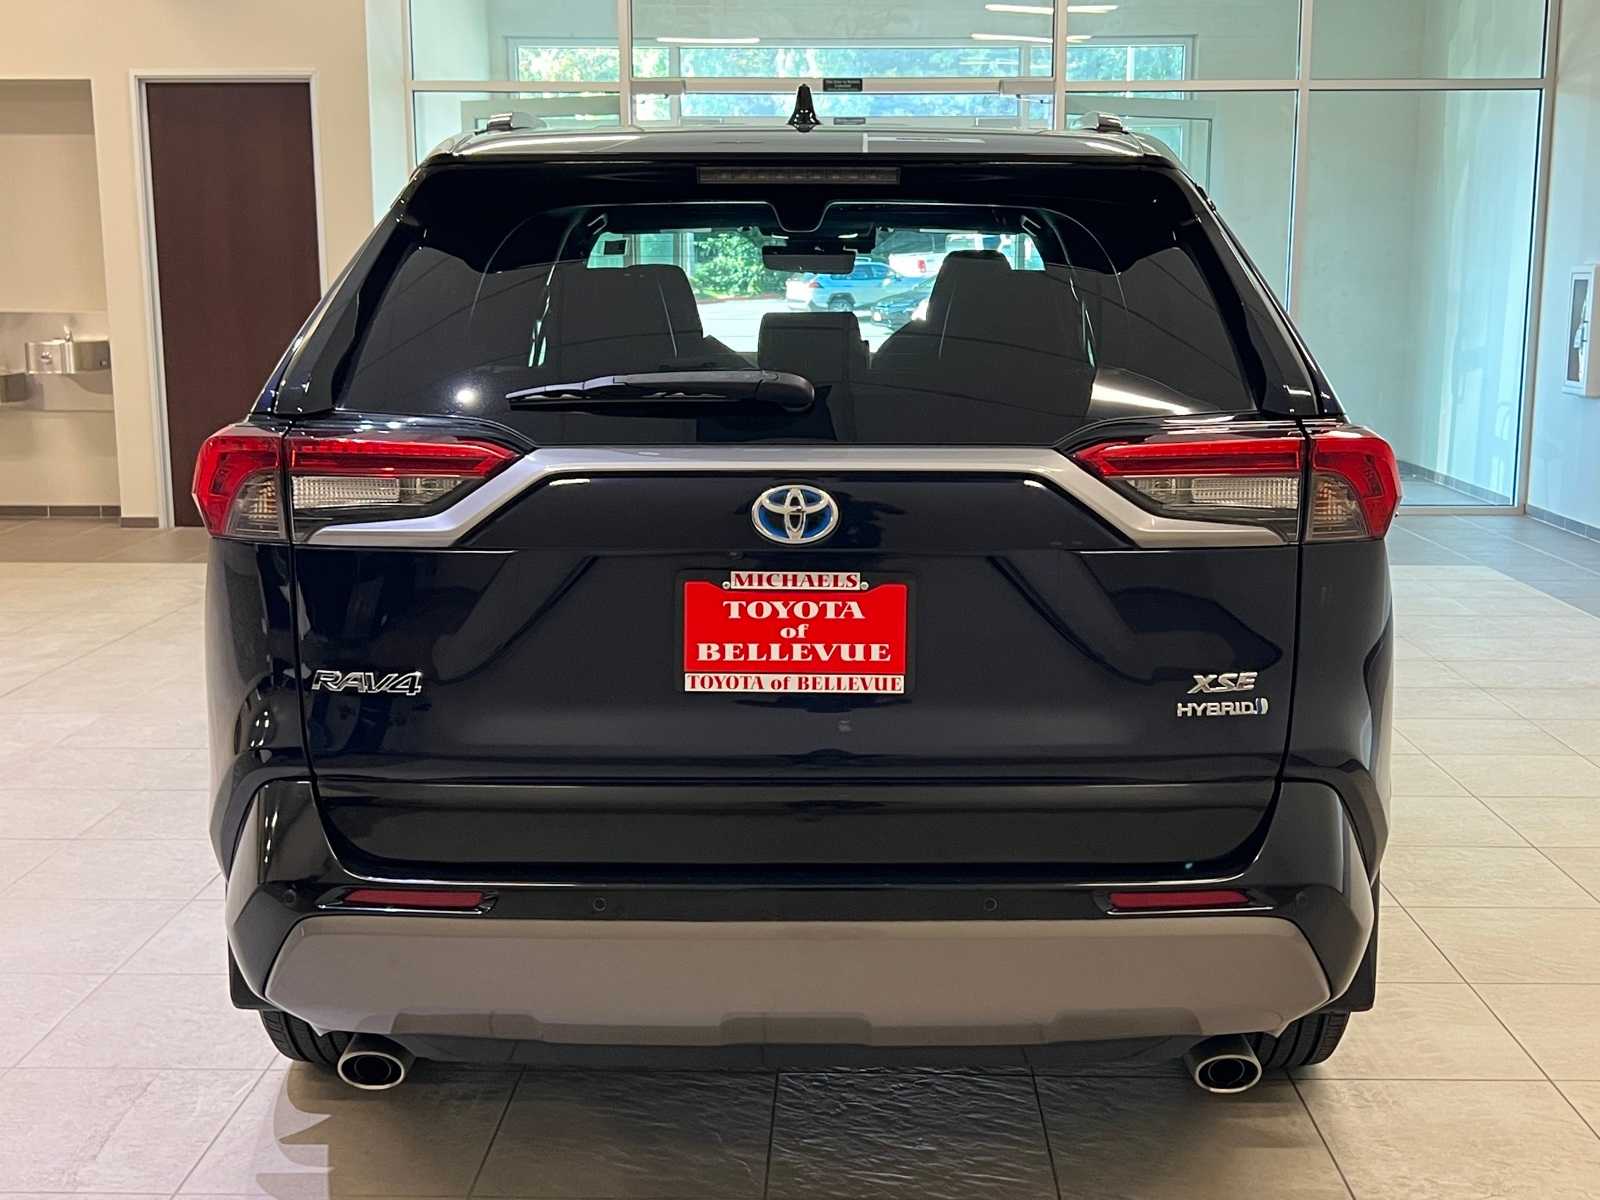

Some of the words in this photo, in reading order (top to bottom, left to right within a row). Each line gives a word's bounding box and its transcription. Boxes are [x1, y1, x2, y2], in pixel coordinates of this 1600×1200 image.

[734, 573, 858, 589] MICHAELS
[722, 600, 866, 620] TOYOTA
[779, 623, 809, 639] of
[696, 643, 891, 662] BELLEVUE
[311, 669, 423, 696] RAV4
[687, 675, 765, 690] TOYOTA
[770, 675, 791, 691] of
[797, 676, 902, 692] BELLEVUE
[1186, 671, 1258, 694] XSE
[1176, 701, 1255, 717] HYBRID
